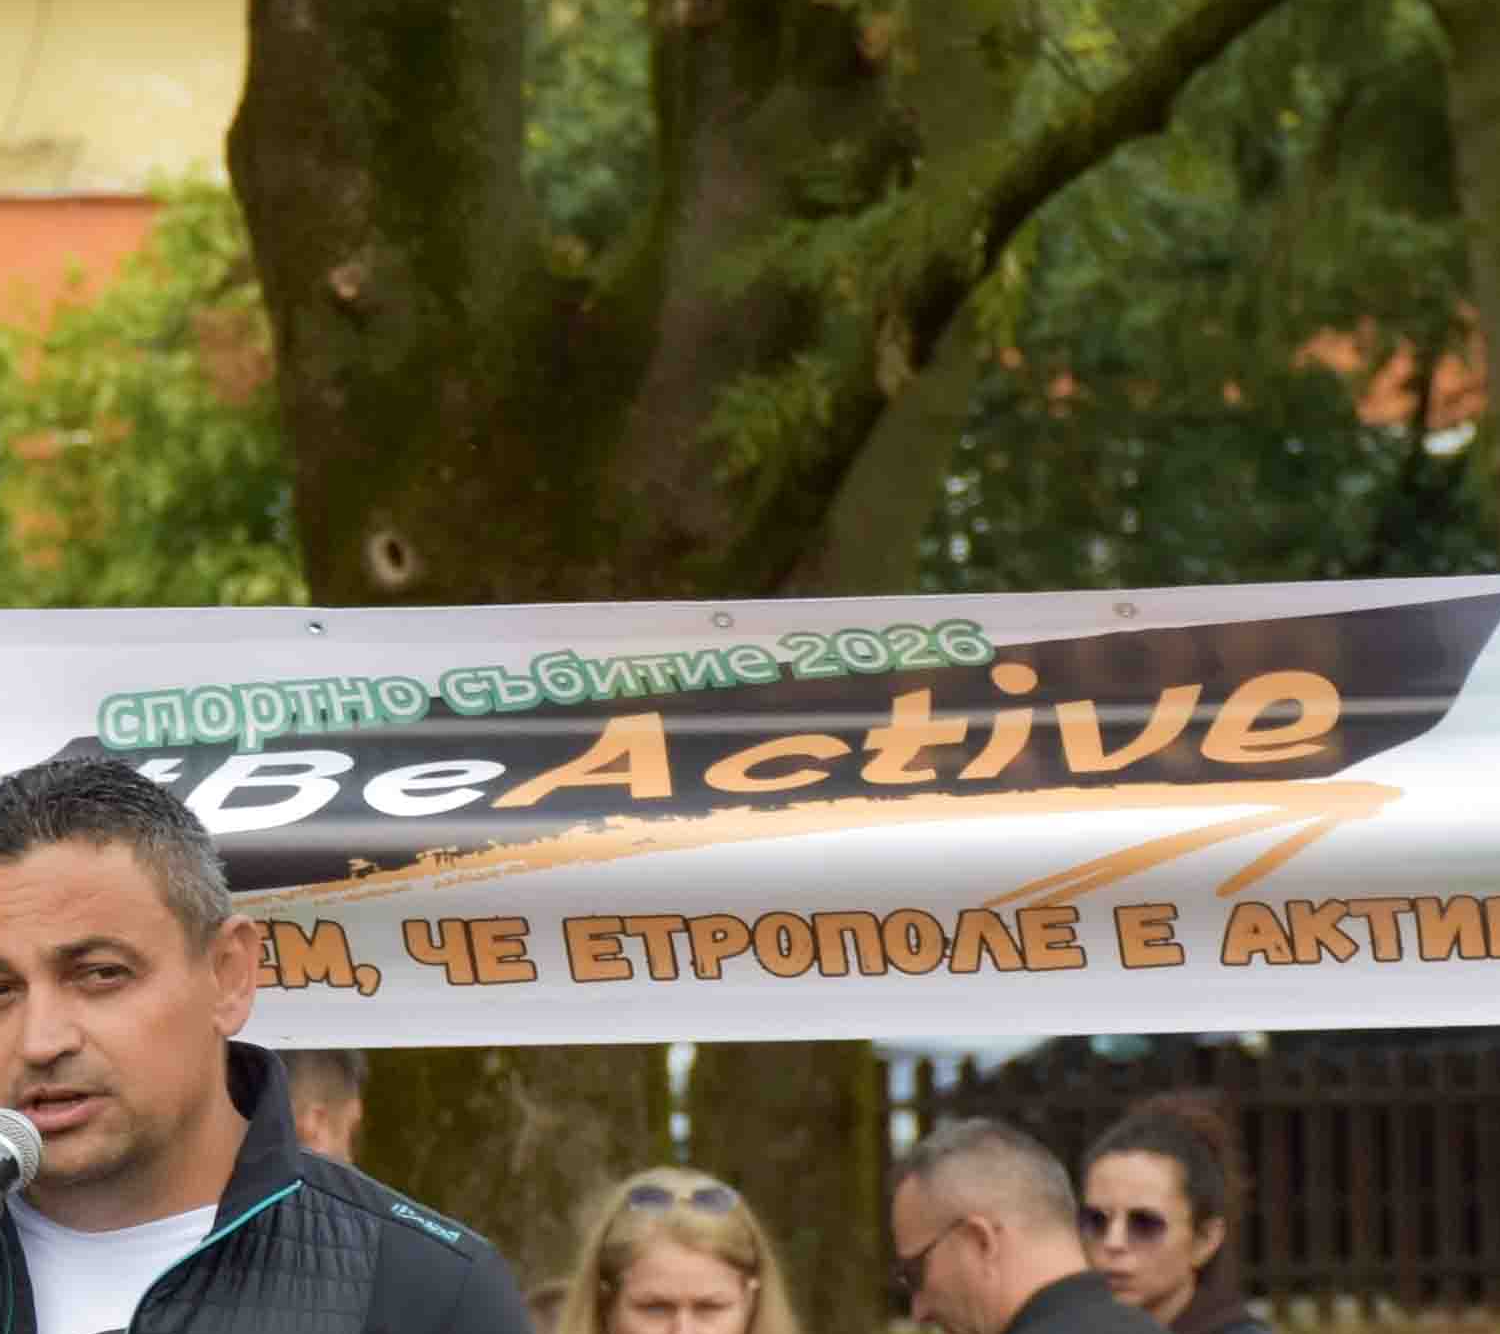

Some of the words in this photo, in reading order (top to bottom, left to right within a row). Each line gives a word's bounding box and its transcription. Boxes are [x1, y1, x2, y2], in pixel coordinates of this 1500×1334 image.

[778, 618, 995, 681] 2026
[402, 915, 537, 985] ЧЕ
[563, 905, 1086, 984] ЕТРОПОЛЕ
[1113, 903, 1185, 969] Е
